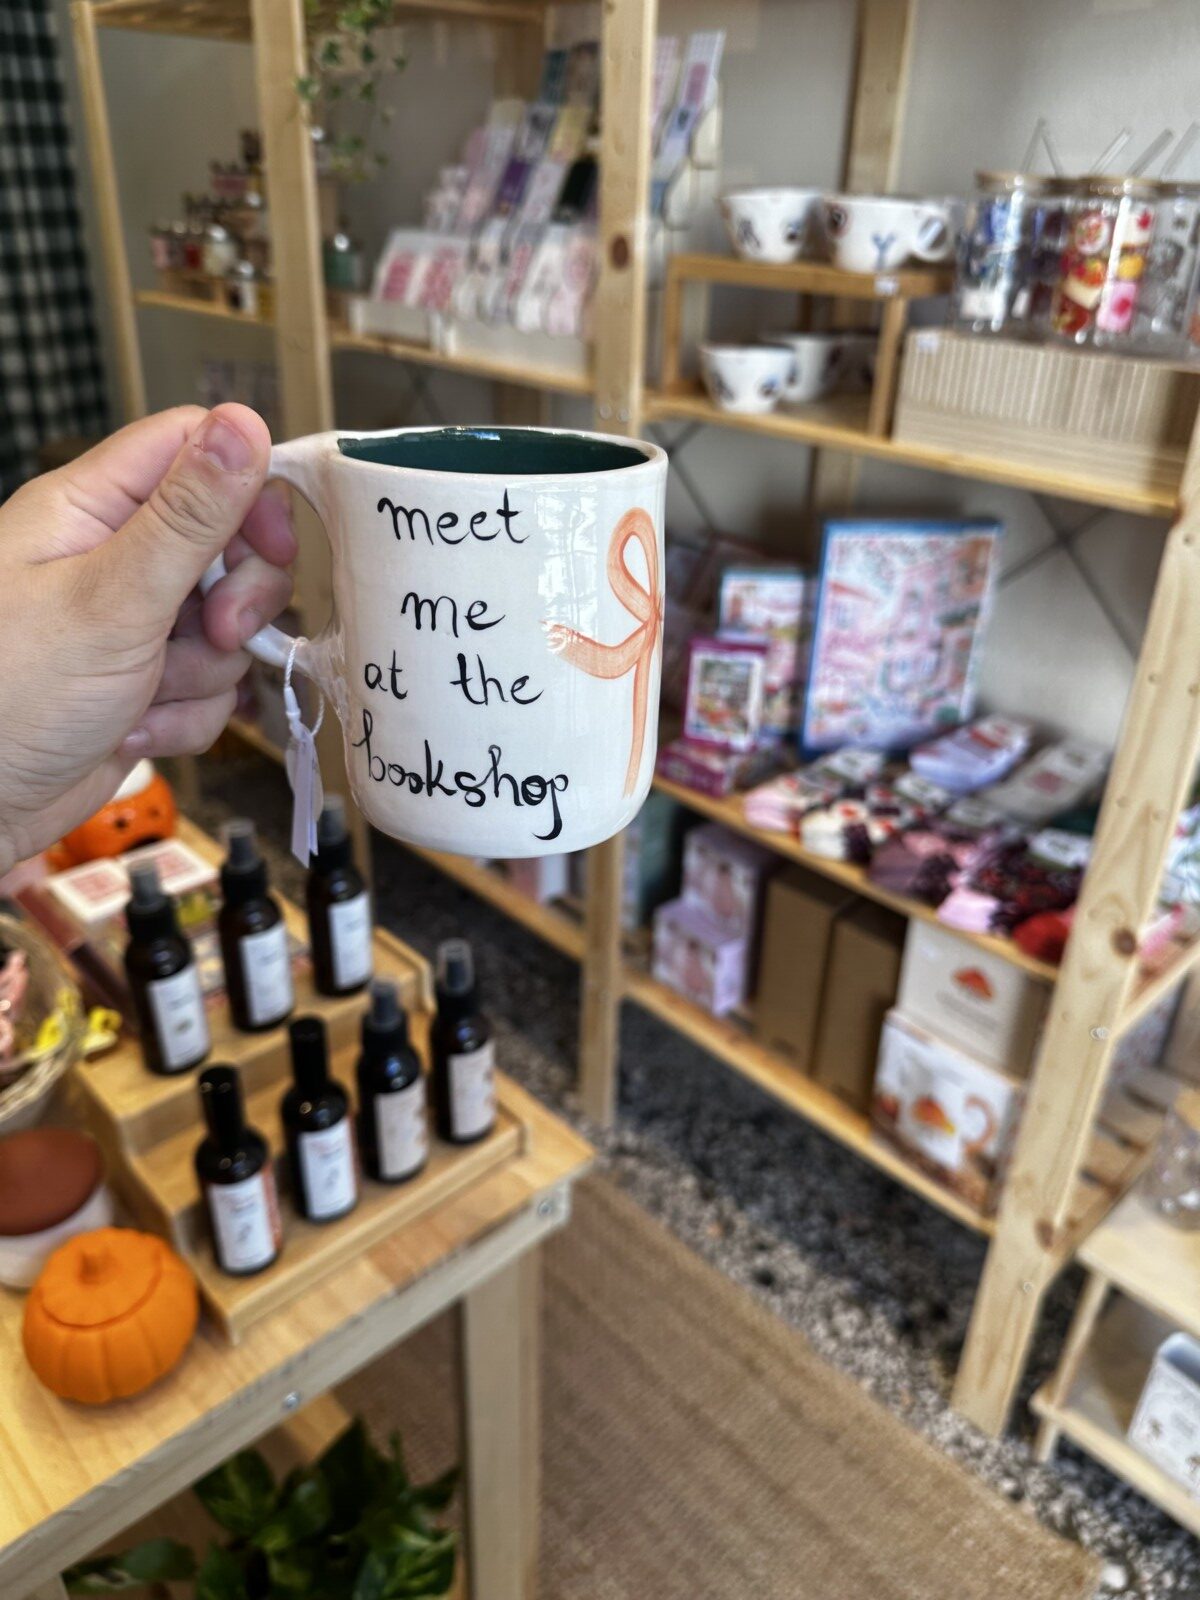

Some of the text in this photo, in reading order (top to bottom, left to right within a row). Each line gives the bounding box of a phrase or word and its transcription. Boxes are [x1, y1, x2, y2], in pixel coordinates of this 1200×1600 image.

[377, 489, 529, 546] meet
[400, 591, 506, 638] me
[364, 650, 544, 706] at the
[352, 708, 569, 840] bookshop
